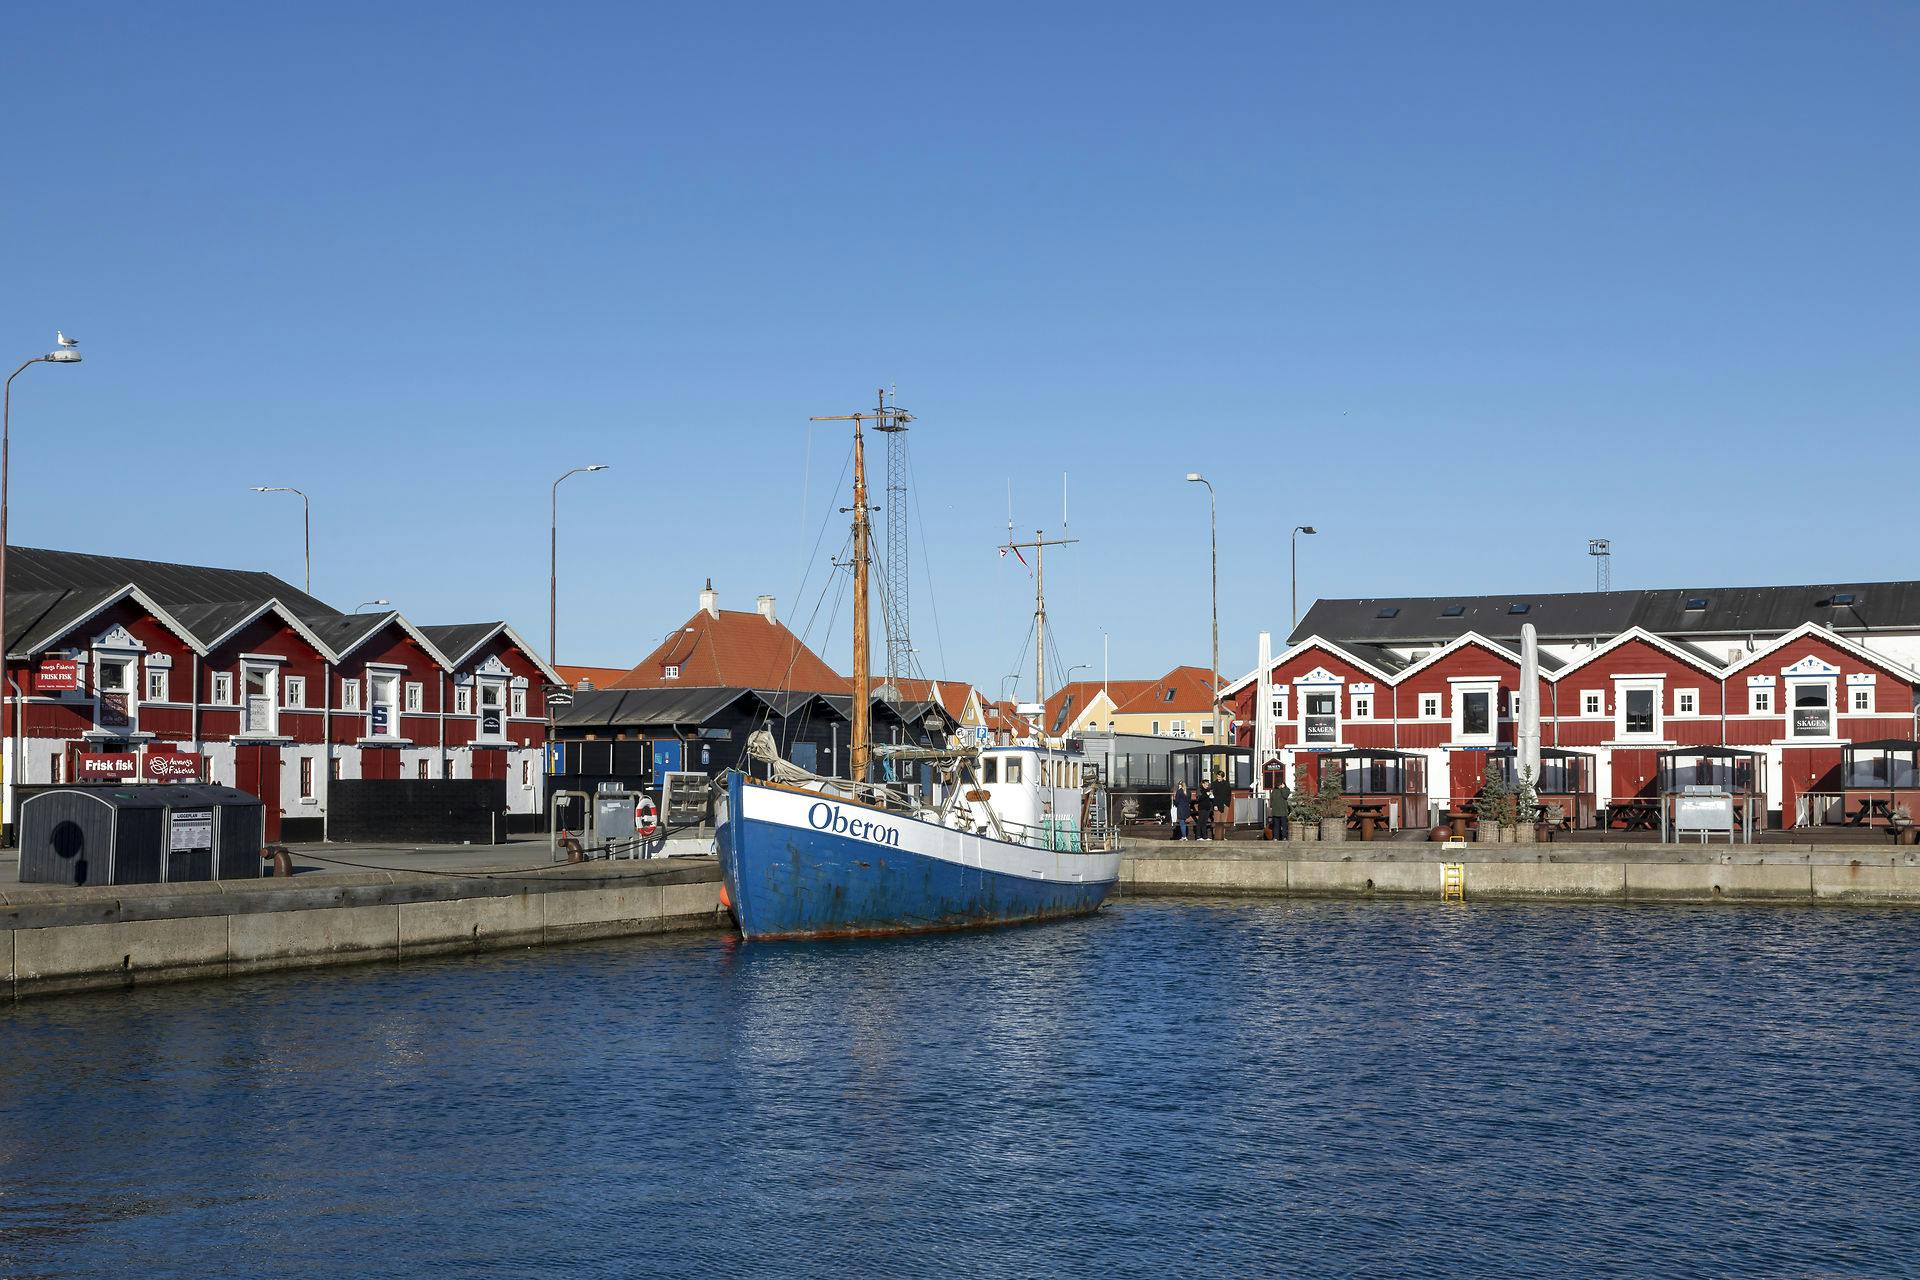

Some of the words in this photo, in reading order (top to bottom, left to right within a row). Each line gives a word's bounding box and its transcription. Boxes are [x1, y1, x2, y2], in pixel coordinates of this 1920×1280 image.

[85, 760, 113, 770] Frisk
[115, 760, 134, 770] fisk
[808, 803, 899, 846] Oberon
